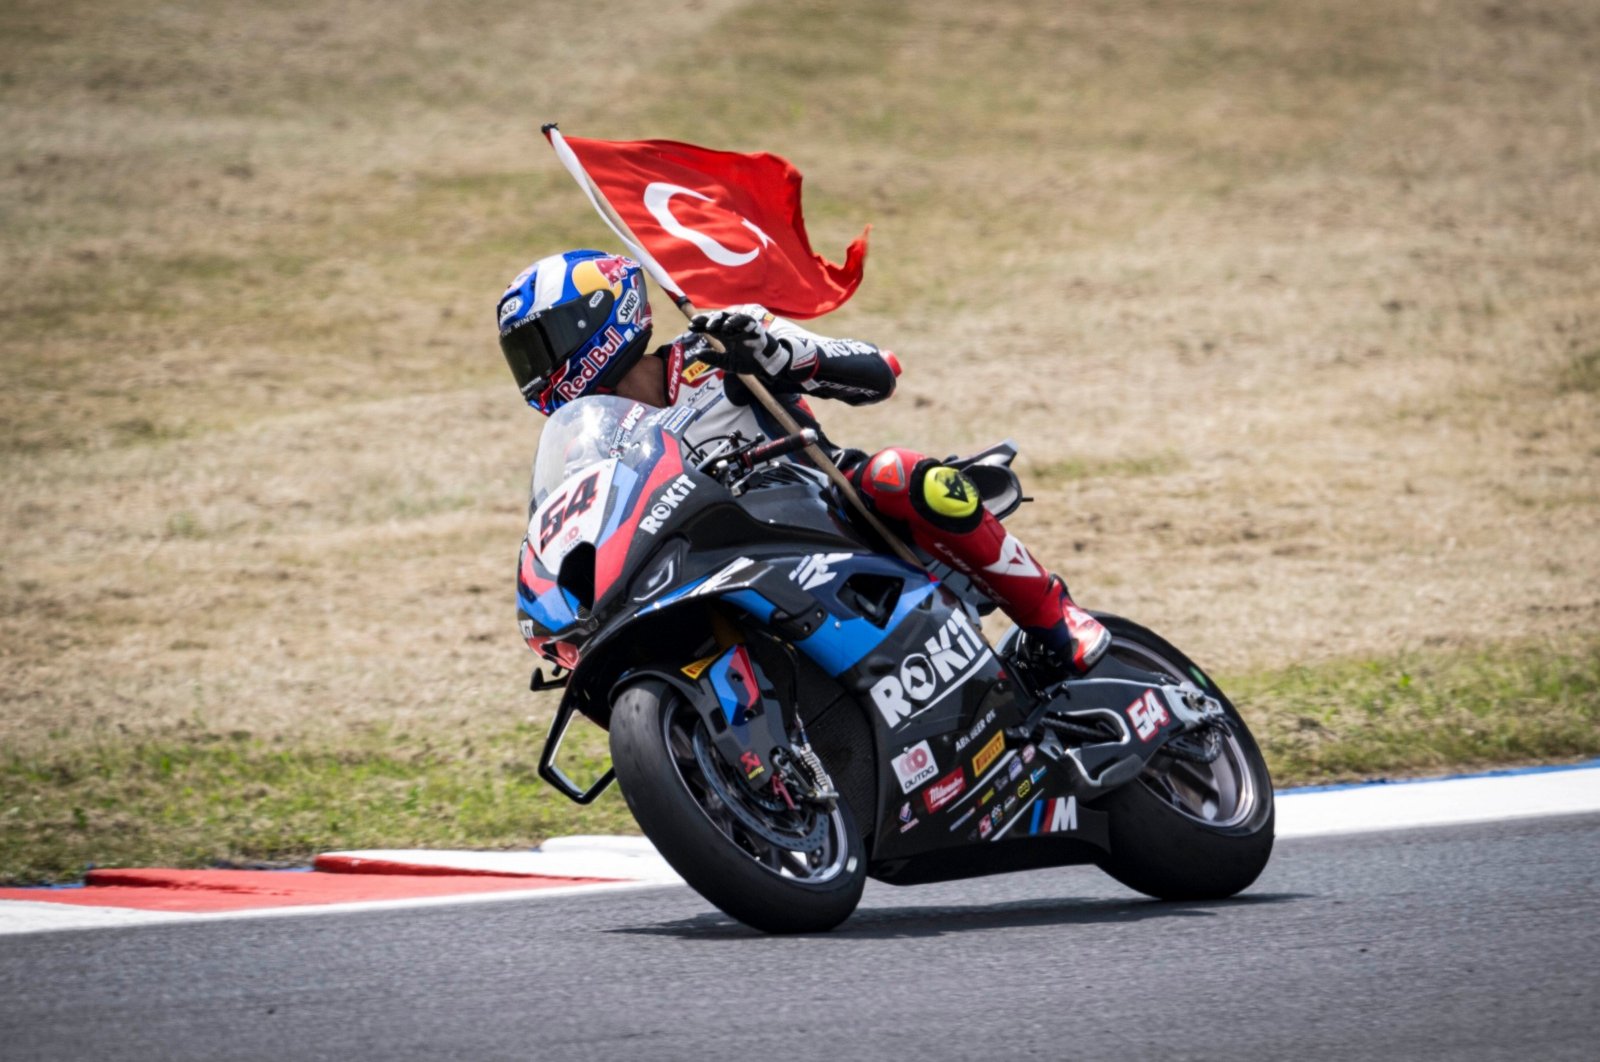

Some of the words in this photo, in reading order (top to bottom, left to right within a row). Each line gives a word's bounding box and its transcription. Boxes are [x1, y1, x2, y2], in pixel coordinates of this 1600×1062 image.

[514, 312, 541, 329] WINGS
[621, 290, 638, 320] SHOEI
[557, 358, 598, 401] Red
[589, 326, 624, 370] Bull
[540, 471, 600, 555] 54
[639, 473, 697, 535] ROKiT
[870, 608, 983, 728] ROKiT
[1126, 689, 1170, 742] 54
[905, 765, 935, 789] OUTDO
[1050, 796, 1077, 832] M
